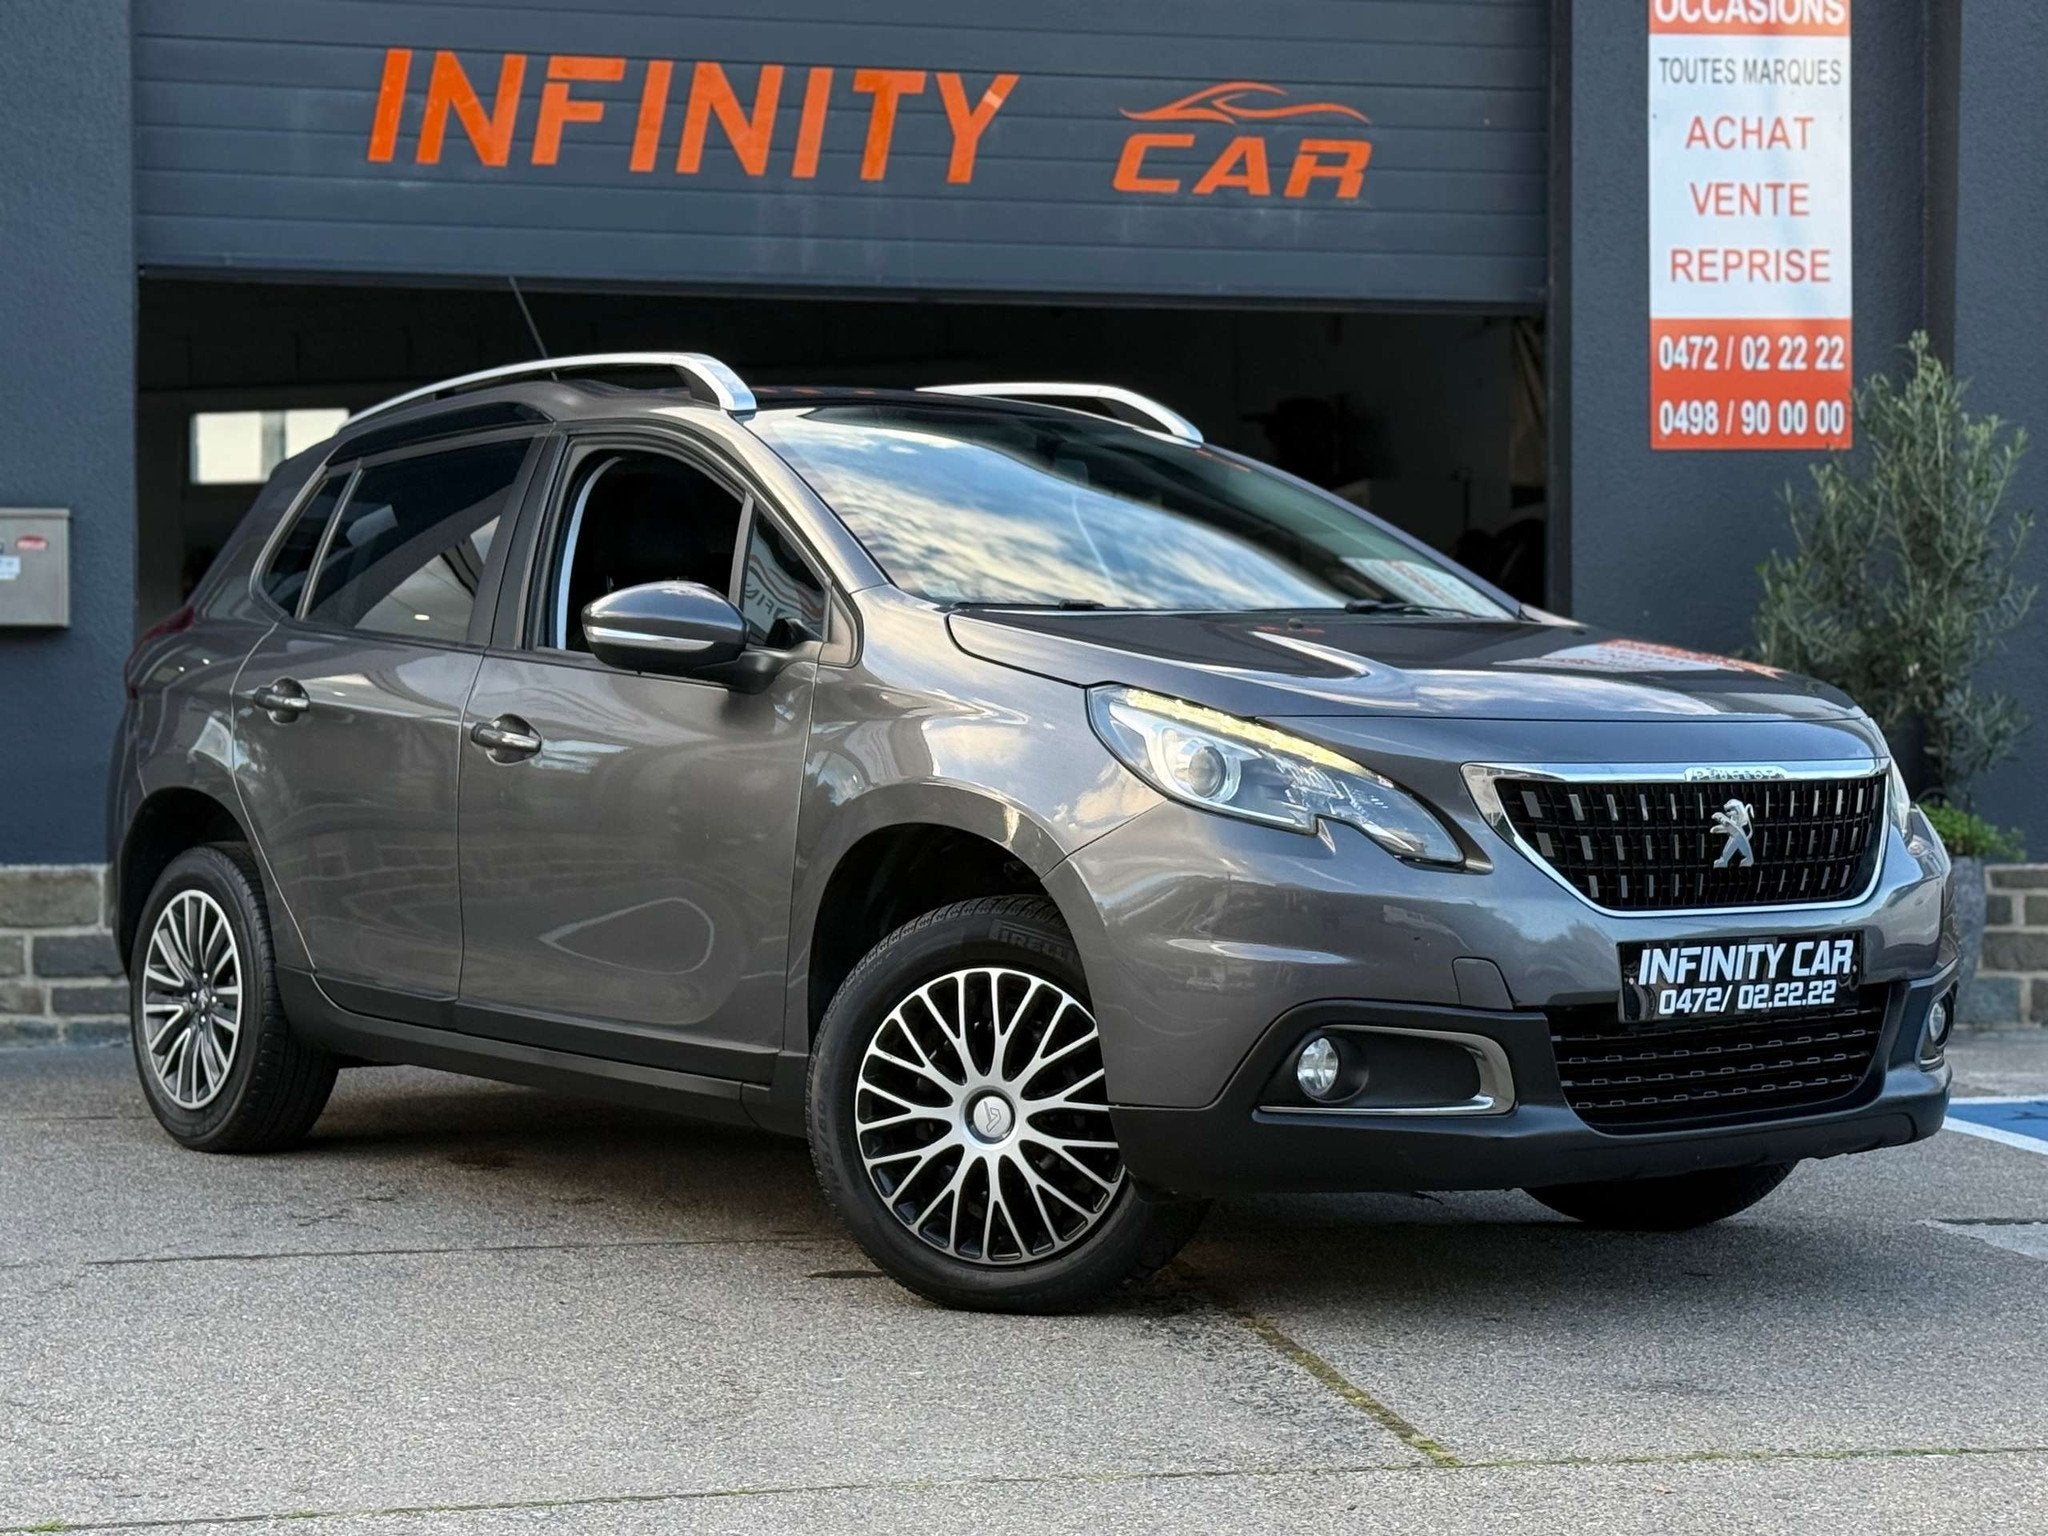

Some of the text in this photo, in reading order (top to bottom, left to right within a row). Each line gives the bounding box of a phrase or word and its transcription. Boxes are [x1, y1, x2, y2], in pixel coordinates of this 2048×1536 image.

[1655, 0, 1846, 24] OCCASIONS
[1659, 58, 1841, 86] TOUTES MARQUES
[367, 48, 1372, 198] INFINITY CAR
[1685, 116, 1814, 149] ACHAT
[1690, 183, 1810, 216] VENTE
[1671, 249, 1831, 283] REPRISE
[1658, 335, 1845, 371] 0472 / 02 22 22
[1659, 399, 1845, 436] 0498 / 90 00 00
[1638, 939, 1854, 985] INFINITY CAR
[1737, 979, 1837, 1010] 02.22.22
